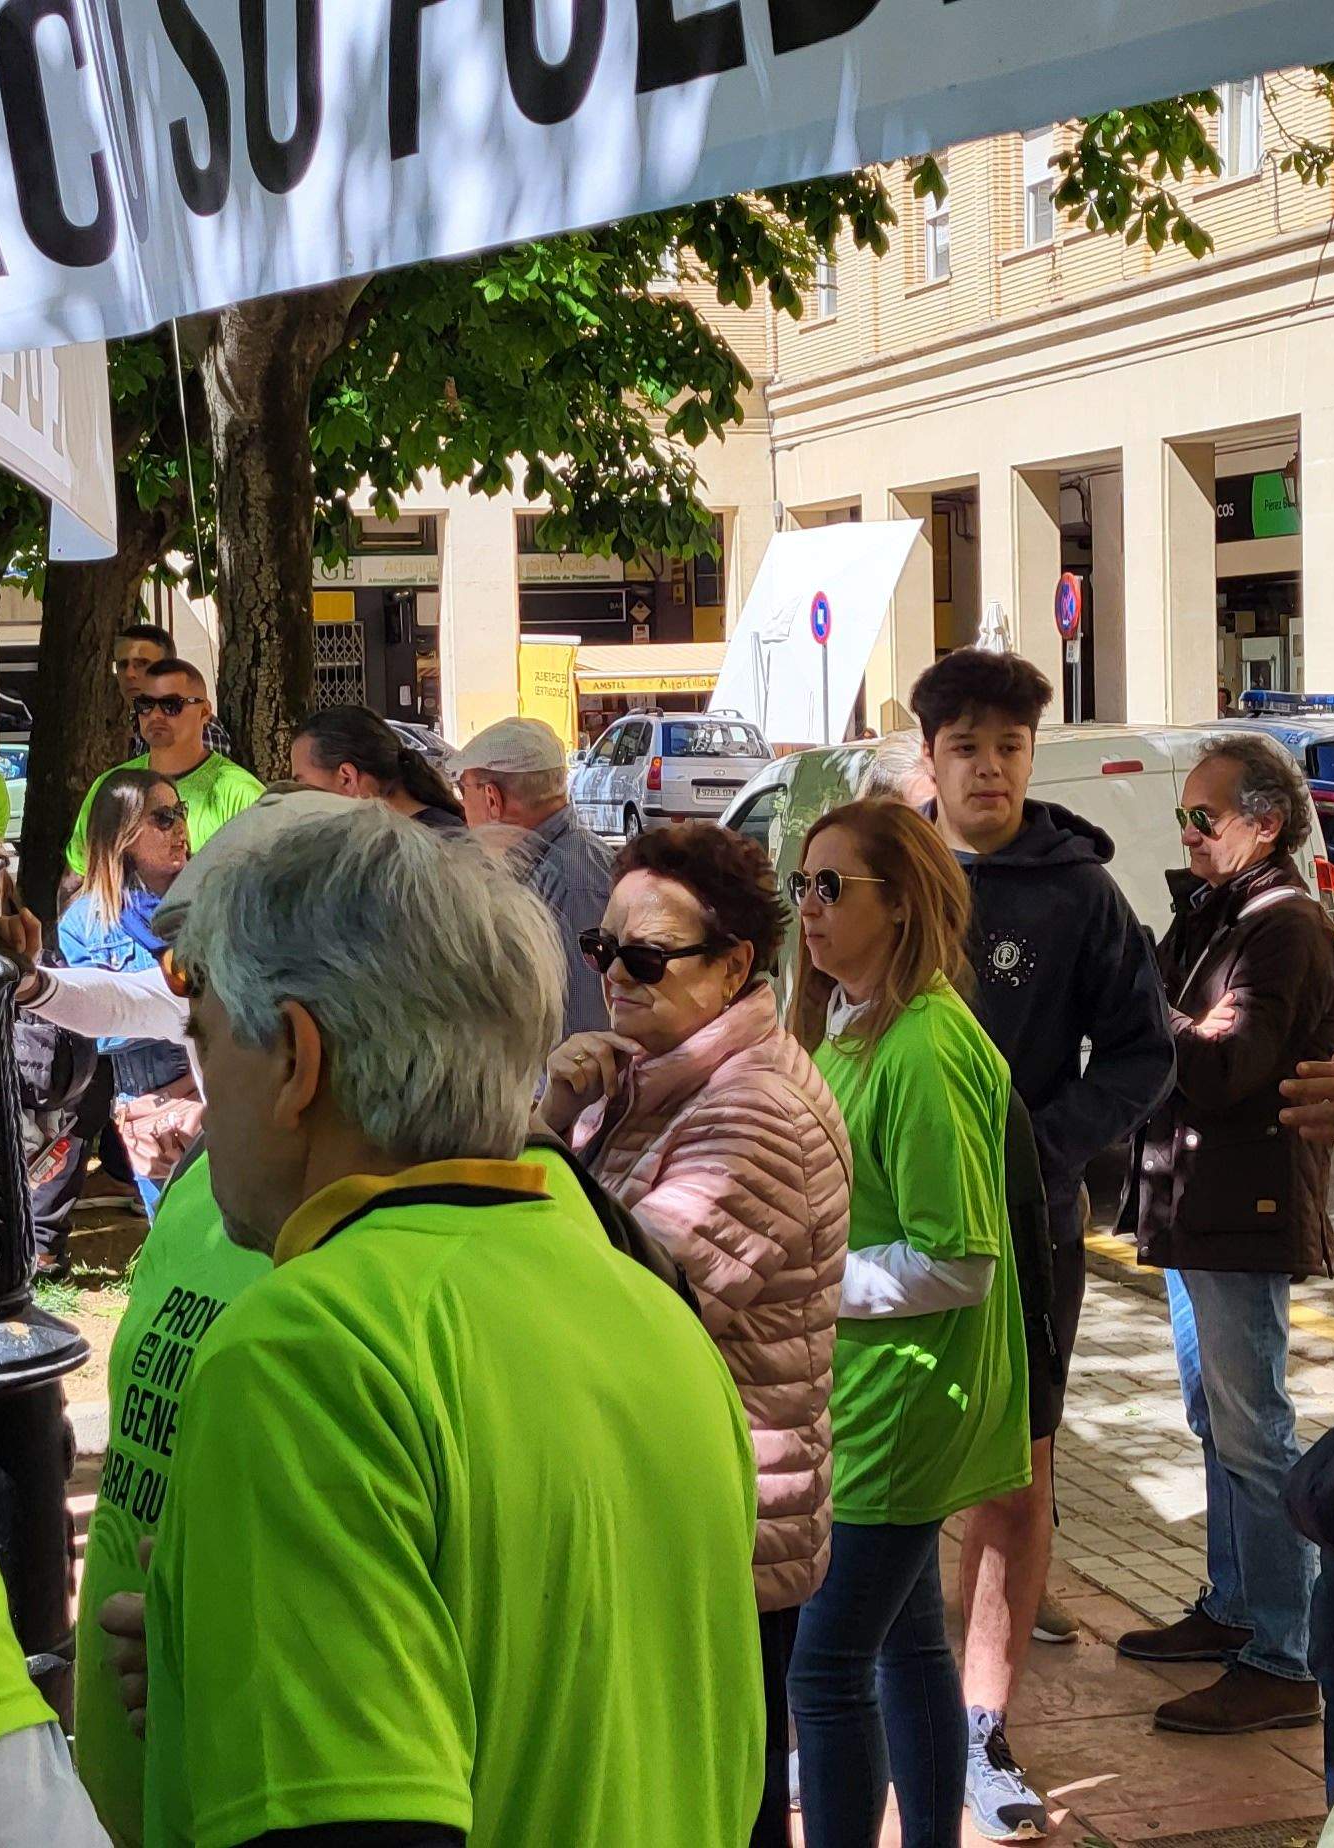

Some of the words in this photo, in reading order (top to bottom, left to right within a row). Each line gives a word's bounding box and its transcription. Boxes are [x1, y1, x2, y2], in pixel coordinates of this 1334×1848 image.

[1217, 502, 1235, 518] COS
[593, 681, 626, 690] AMSTEL
[151, 1285, 227, 1344] PROY
[151, 1339, 195, 1393] INT
[120, 1383, 179, 1457] GENE
[131, 1467, 169, 1525] QU
